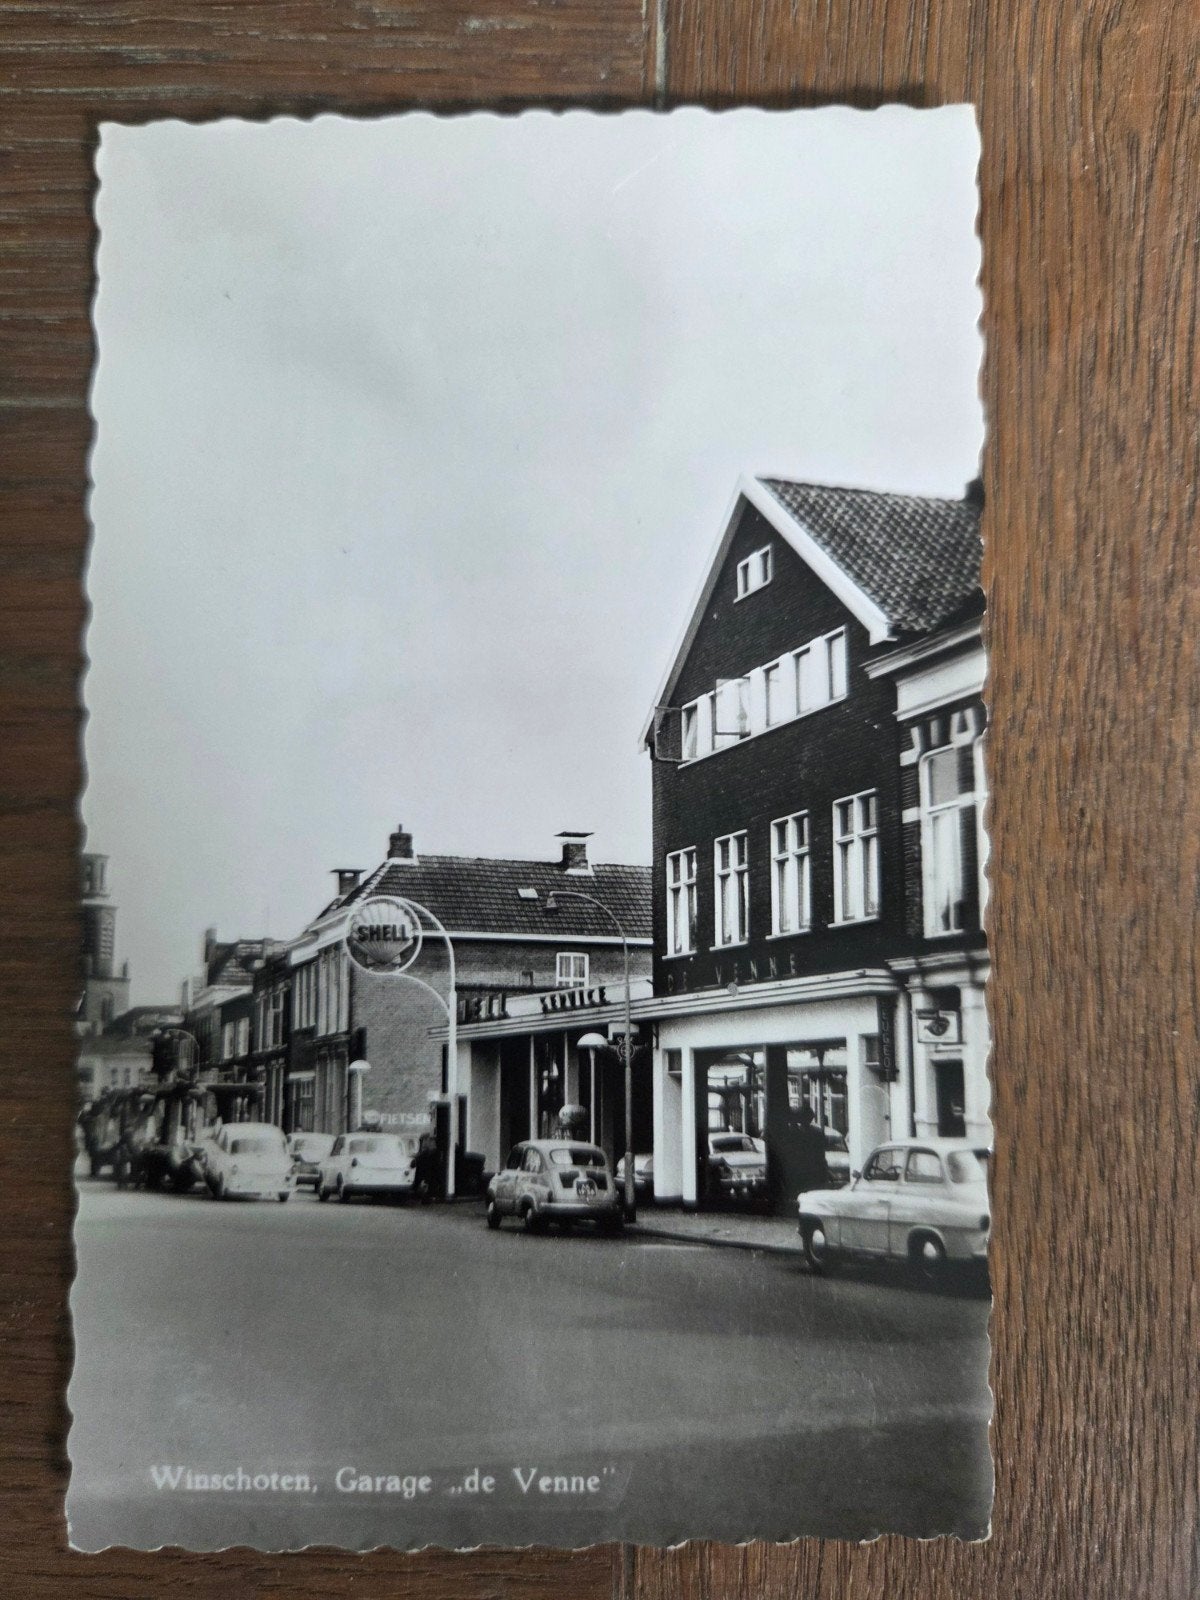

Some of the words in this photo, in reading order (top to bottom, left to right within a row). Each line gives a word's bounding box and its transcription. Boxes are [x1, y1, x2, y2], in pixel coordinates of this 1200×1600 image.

[357, 924, 409, 942] SHELL
[667, 971, 688, 992] DE
[715, 953, 796, 985] VENNE
[540, 986, 612, 1014] SERVICE
[881, 999, 891, 1080] EUGEOT
